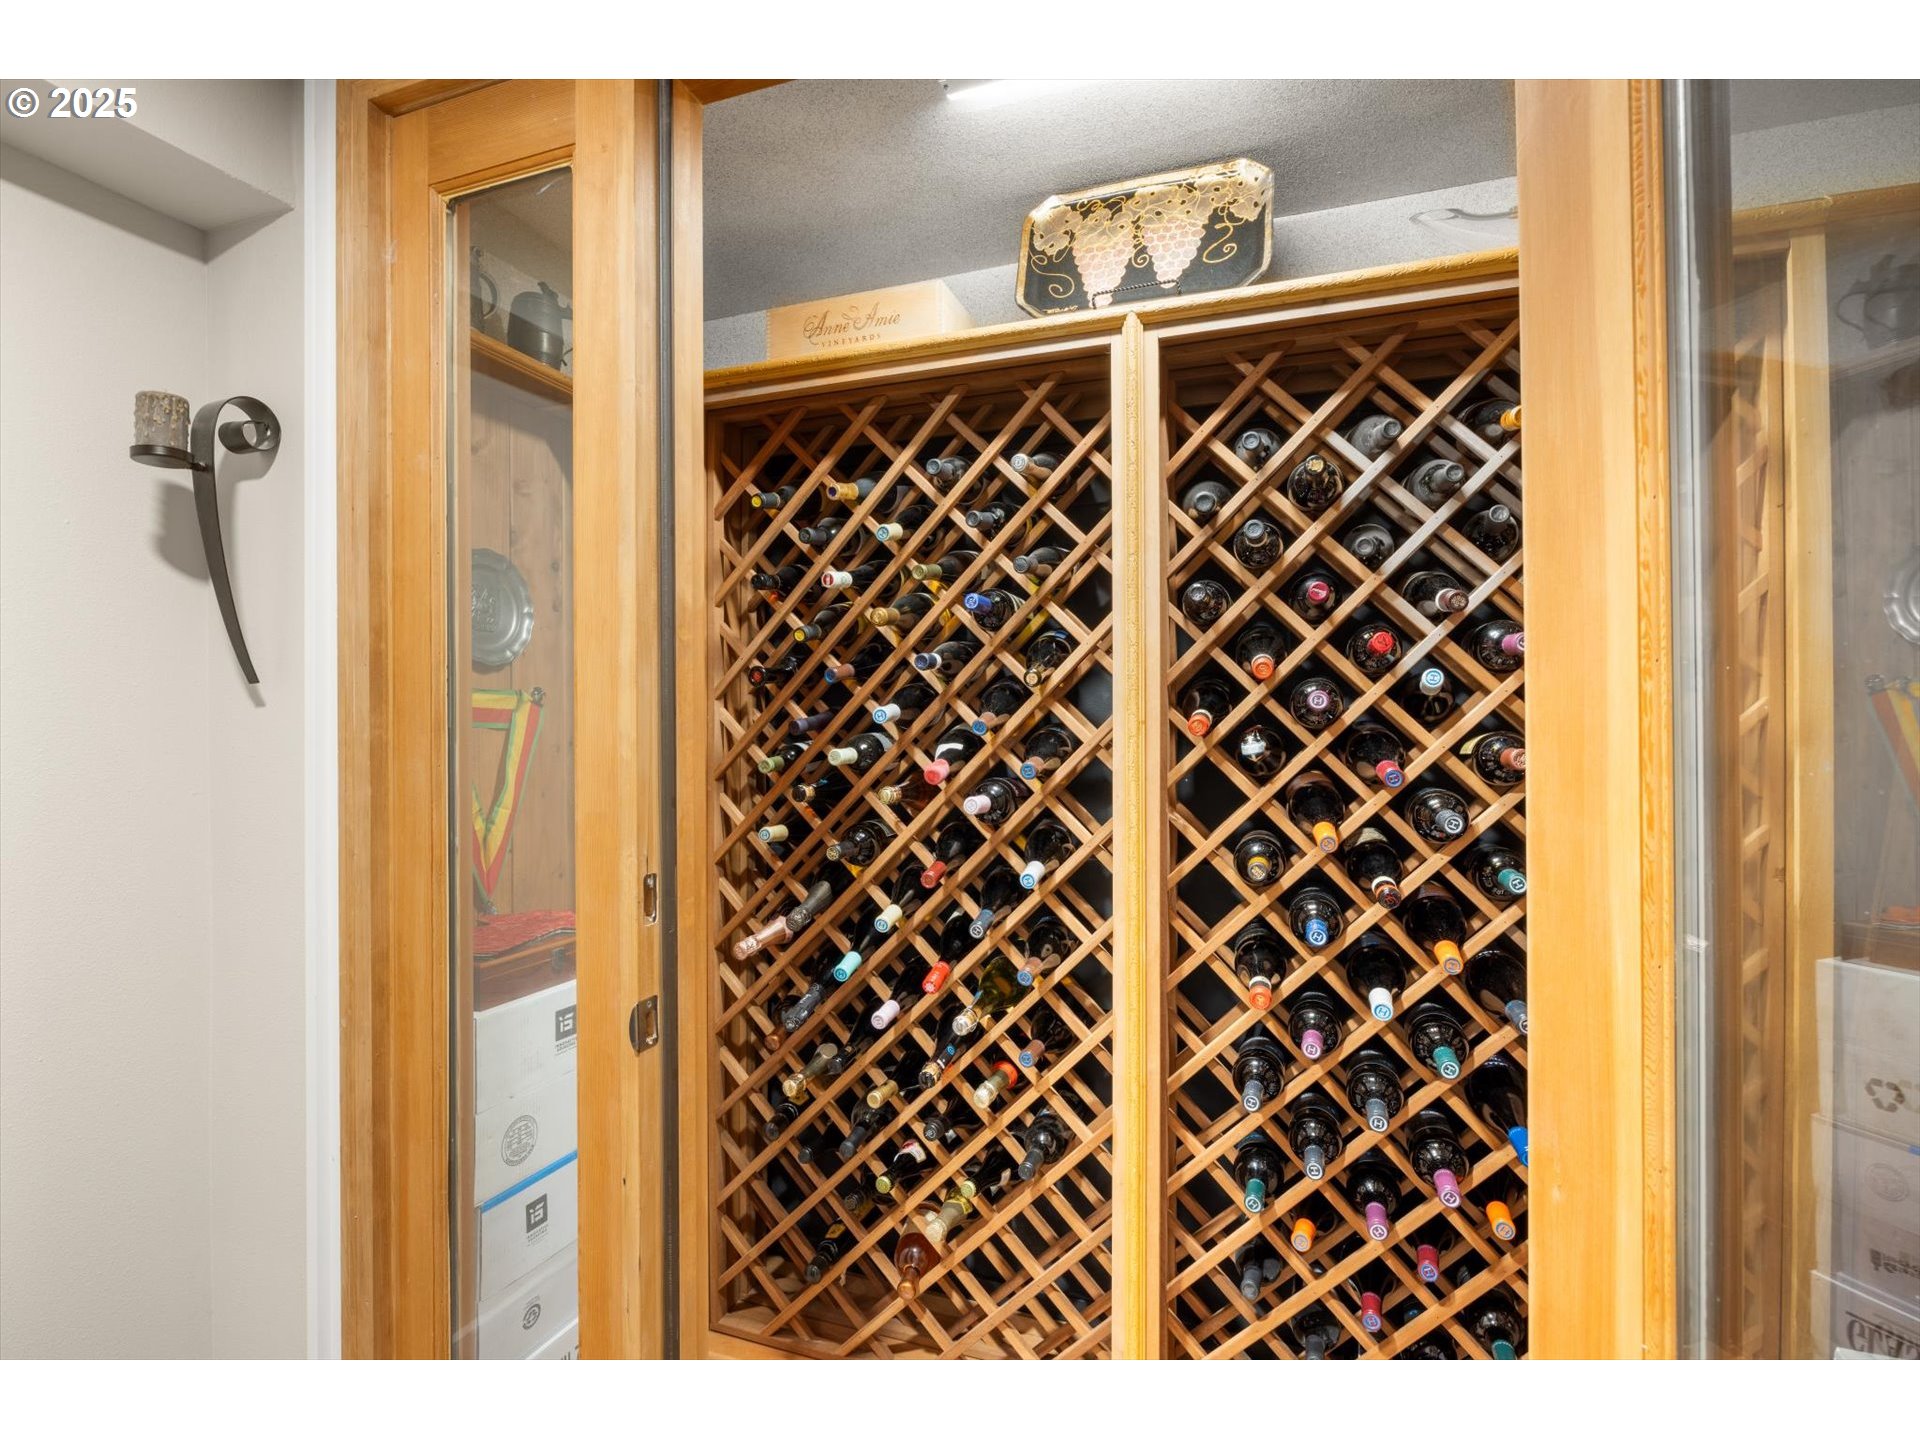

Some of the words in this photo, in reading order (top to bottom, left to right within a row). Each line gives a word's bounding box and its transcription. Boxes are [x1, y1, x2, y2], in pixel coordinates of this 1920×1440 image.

[803, 310, 850, 345] Anne
[853, 302, 901, 330] Amie
[821, 333, 882, 348] VINEYARDS
